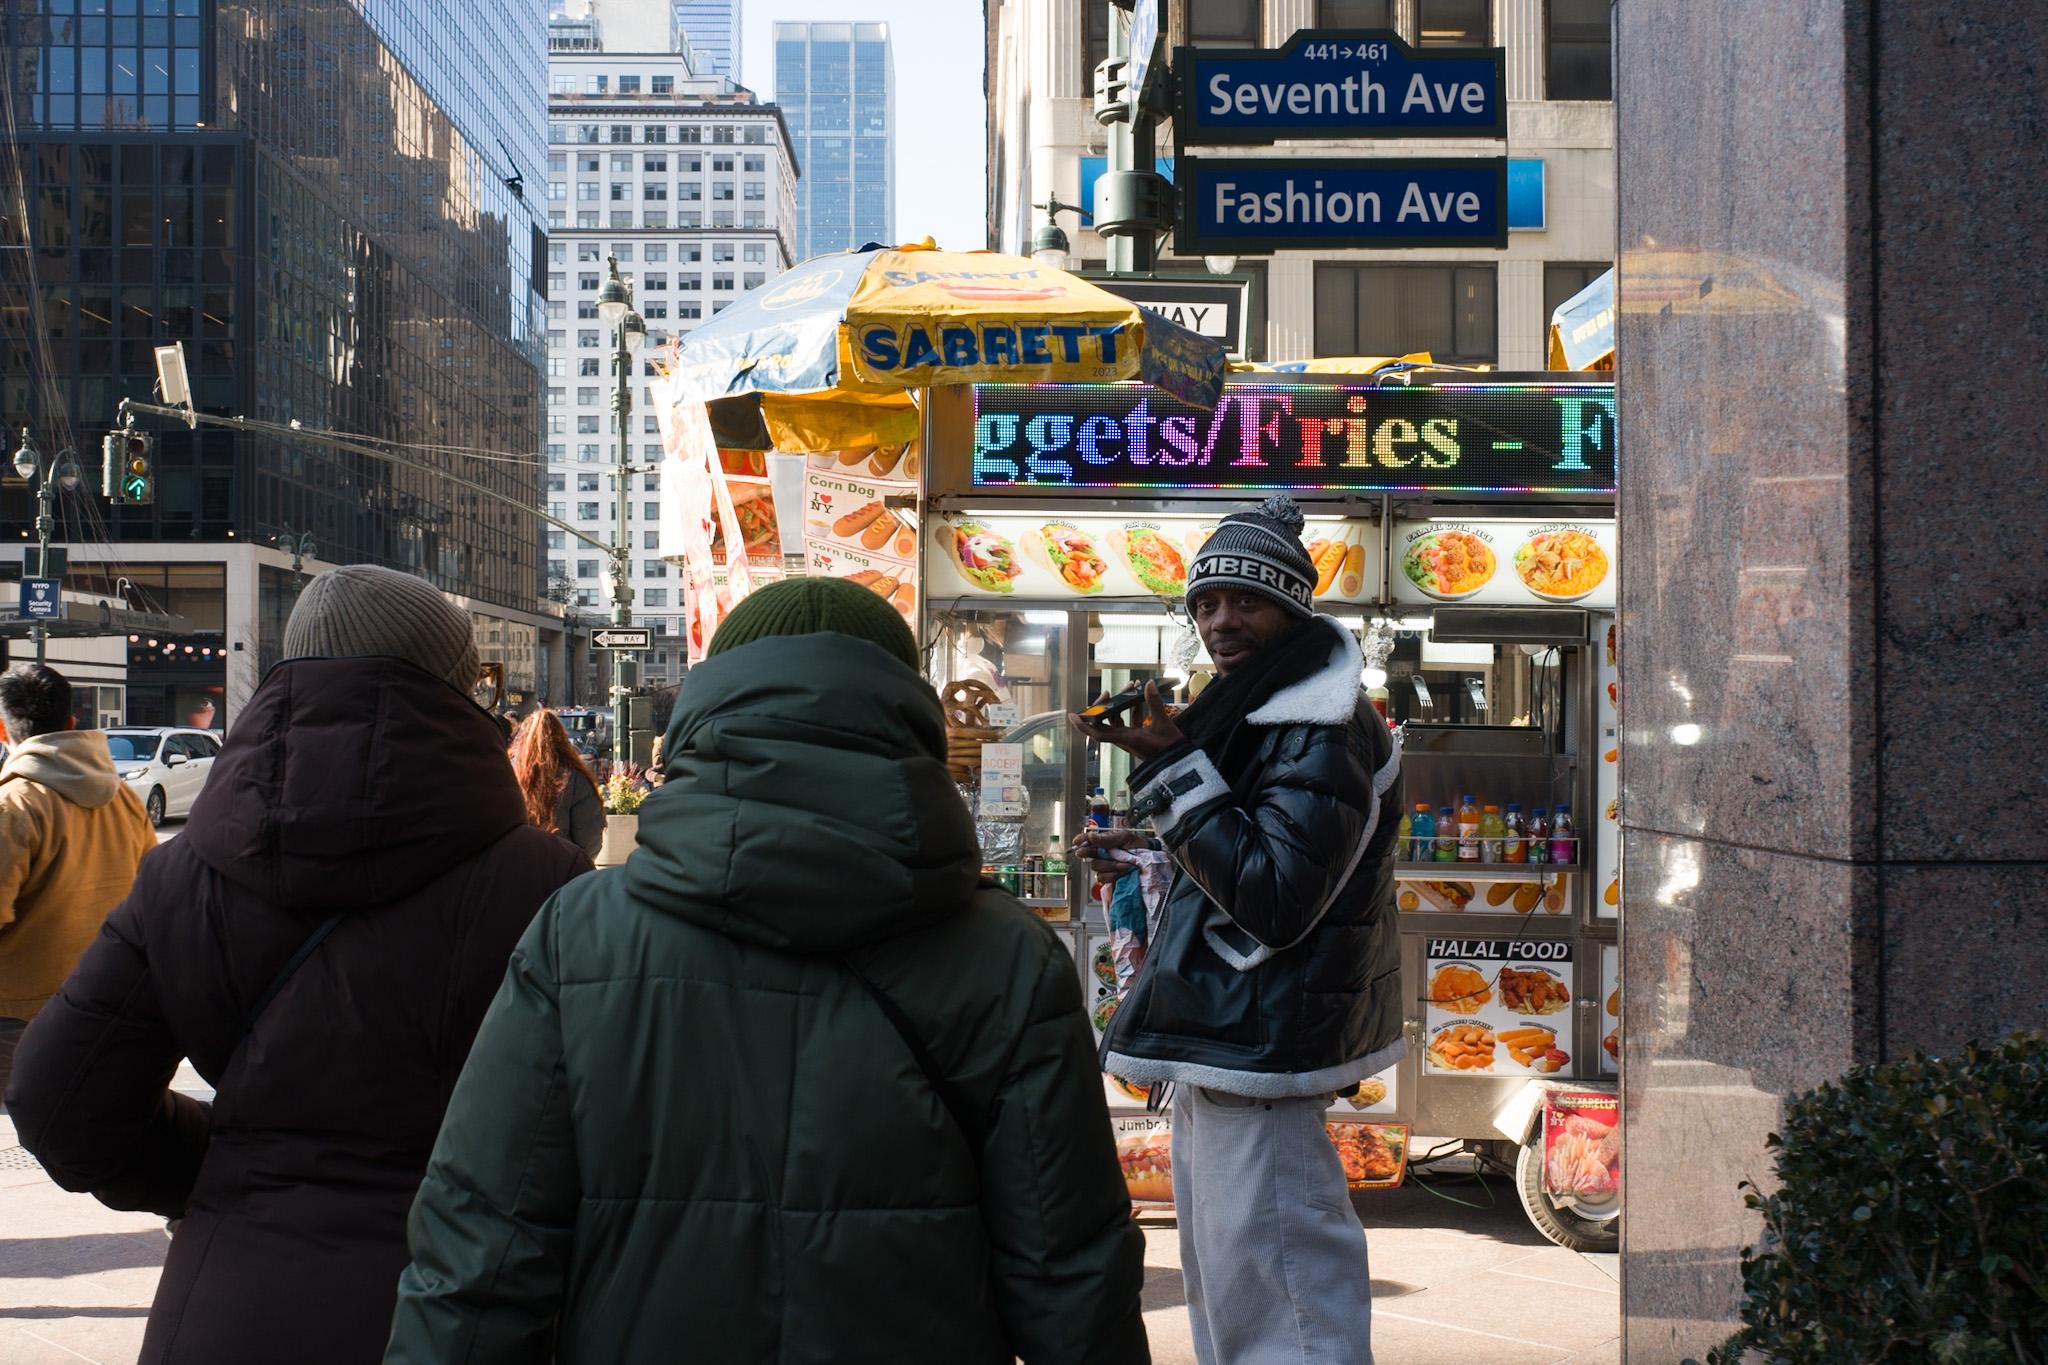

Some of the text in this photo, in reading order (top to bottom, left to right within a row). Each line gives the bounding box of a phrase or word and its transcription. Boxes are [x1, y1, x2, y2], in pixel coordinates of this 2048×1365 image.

[1304, 43, 1388, 60] 441 461
[1209, 71, 1485, 115] Seventh Ave
[1215, 180, 1480, 224] Fashion Ave
[858, 320, 1125, 371] SABRETT
[1092, 367, 1118, 377] 2023
[809, 475, 875, 498] Corn Dog
[810, 500, 834, 514] NY
[1405, 524, 1444, 543] FALAFEL
[1446, 522, 1470, 533] OVER
[1527, 524, 1559, 538] COMBO
[809, 541, 870, 567] Corn Dog
[1191, 556, 1313, 608] MBERLAN
[28, 600, 52, 608] Security
[600, 635, 640, 643] ONE WAY
[983, 758, 1020, 769] ACCEPT
[1430, 940, 1568, 959] HALAL FOOD
